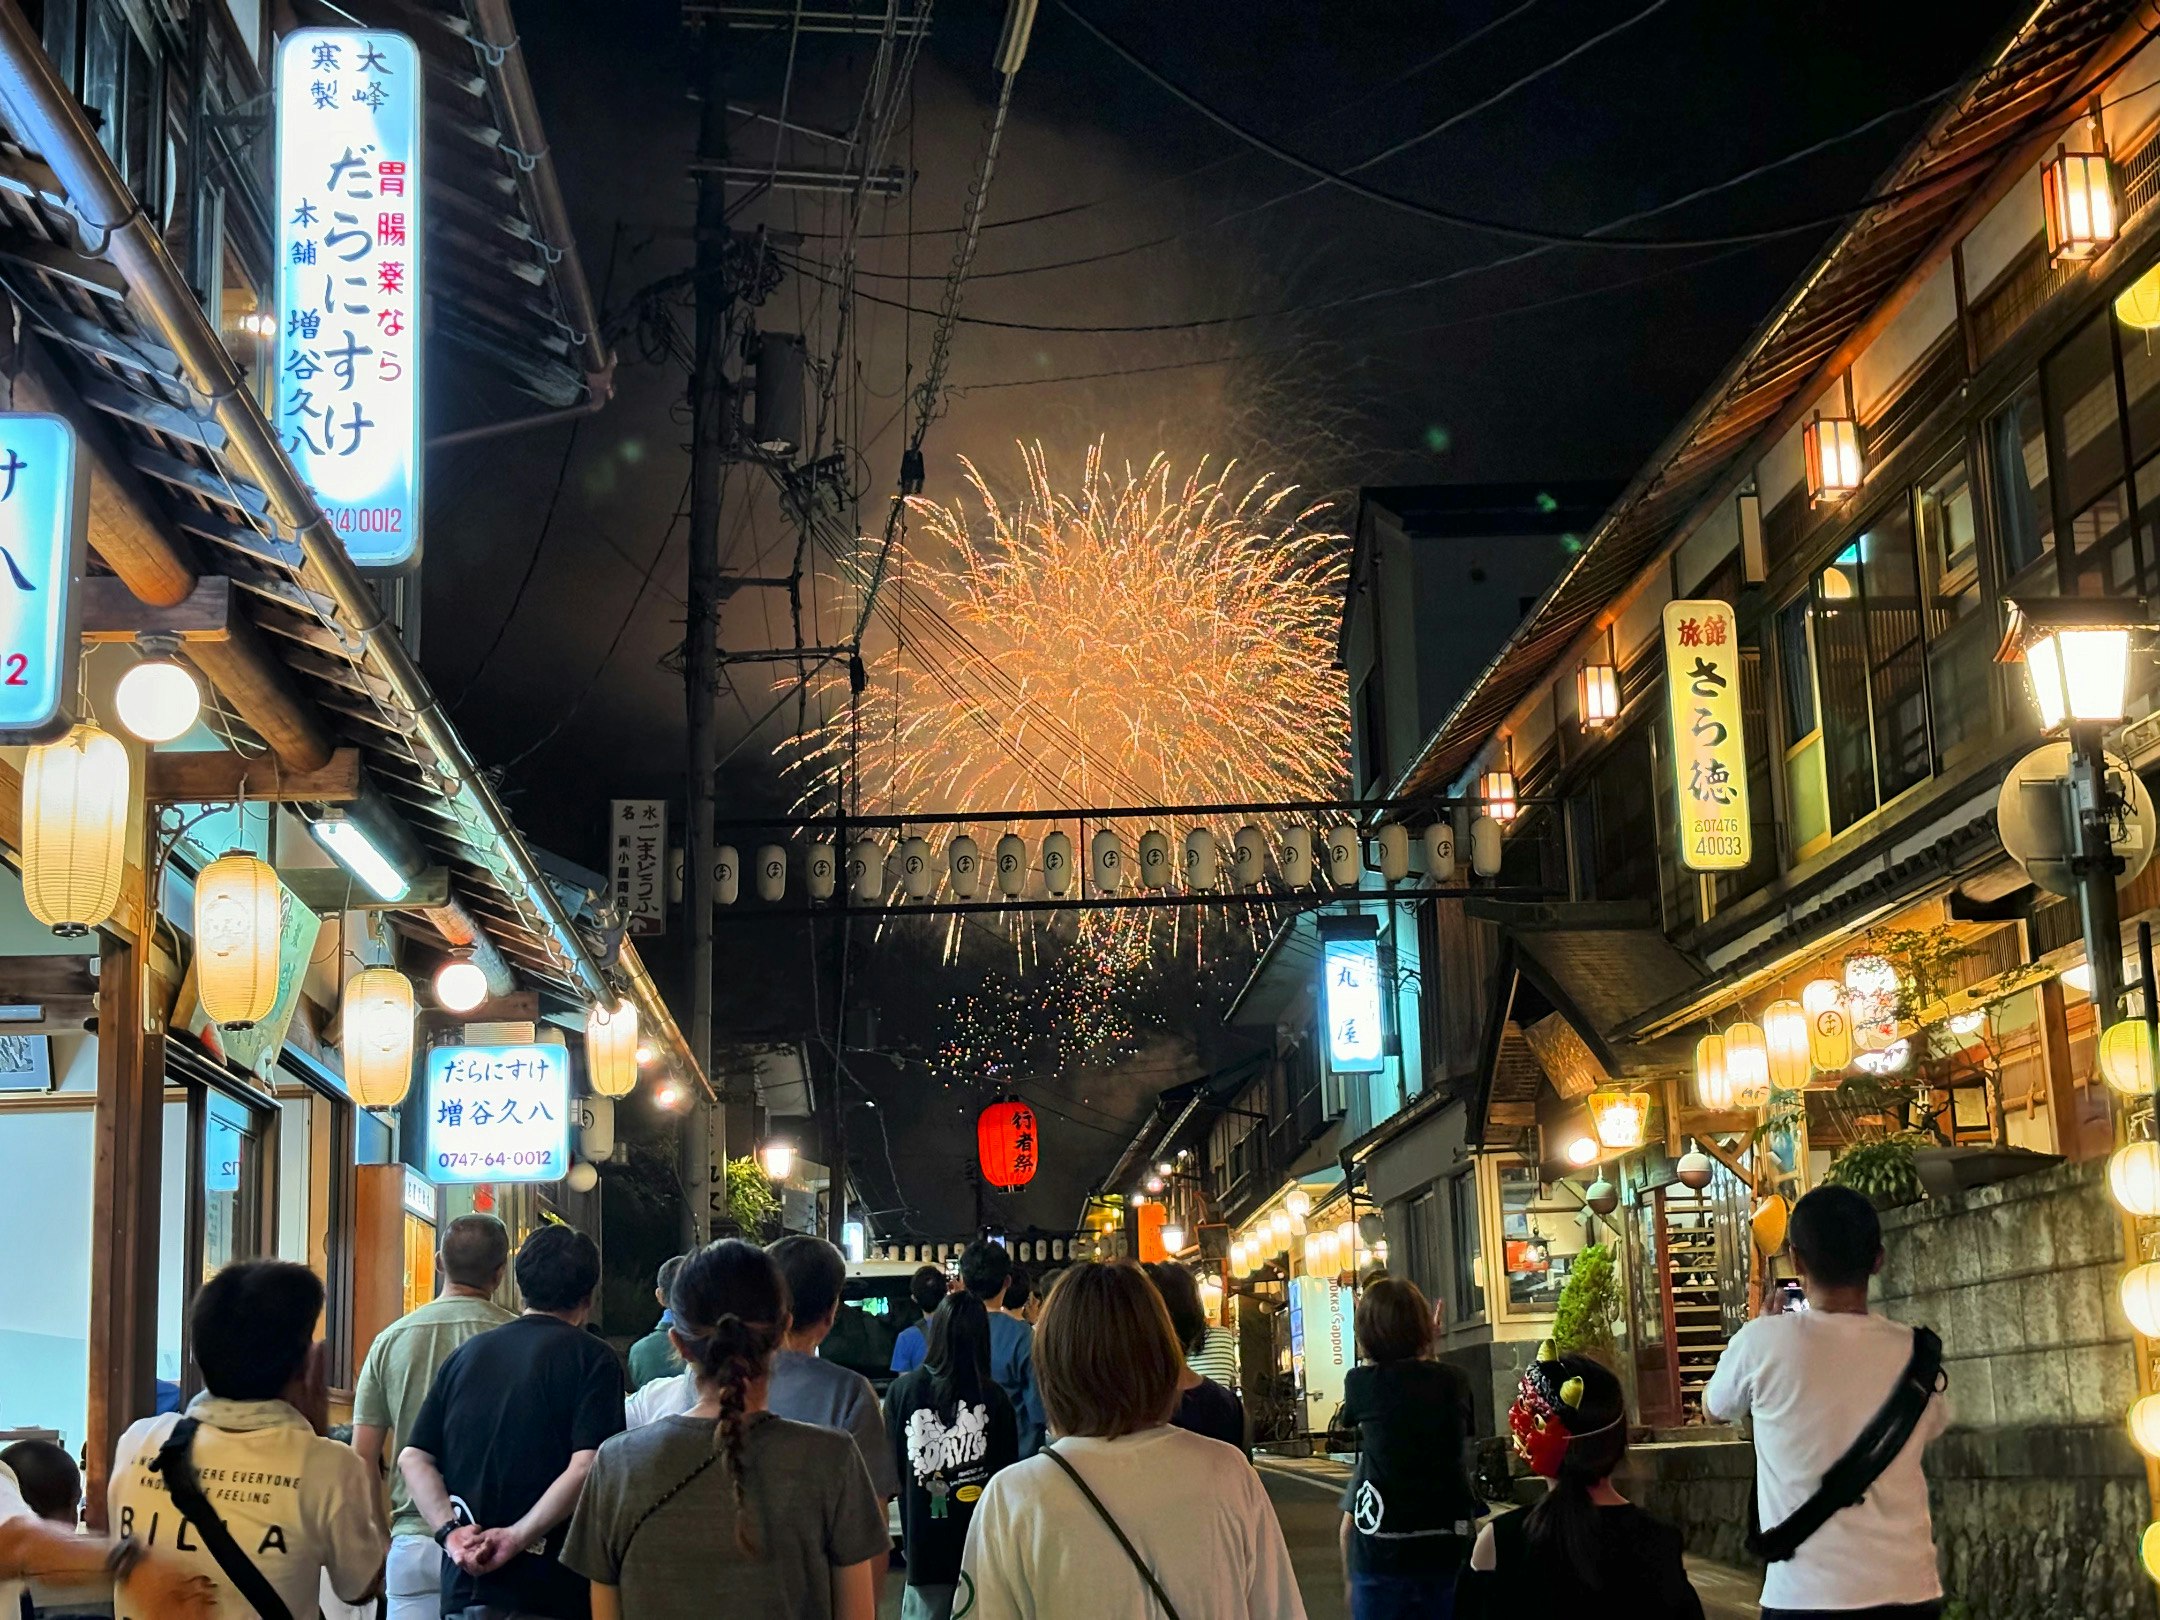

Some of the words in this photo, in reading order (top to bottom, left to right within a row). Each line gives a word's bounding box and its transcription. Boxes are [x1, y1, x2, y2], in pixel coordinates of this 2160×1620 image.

[310, 41, 342, 110] 寒製
[352, 41, 394, 114] 大峰
[324, 145, 376, 457] だらにすけ
[376, 161, 407, 382] 胃腸薬なら
[284, 308, 326, 457] 増谷久八
[1677, 614, 1728, 648] 旅館
[1686, 656, 1738, 805] さら徳
[1337, 966, 1360, 1044] 丸屋
[444, 1059, 550, 1083] だらにすけ
[437, 1098, 555, 1128] 増谷久八
[1012, 1110, 1034, 1173] 行者祭
[438, 1150, 553, 1168] 0747-64-0012
[216, 1488, 271, 1505] FEELING
[231, 1471, 301, 1490] EVERYONE
